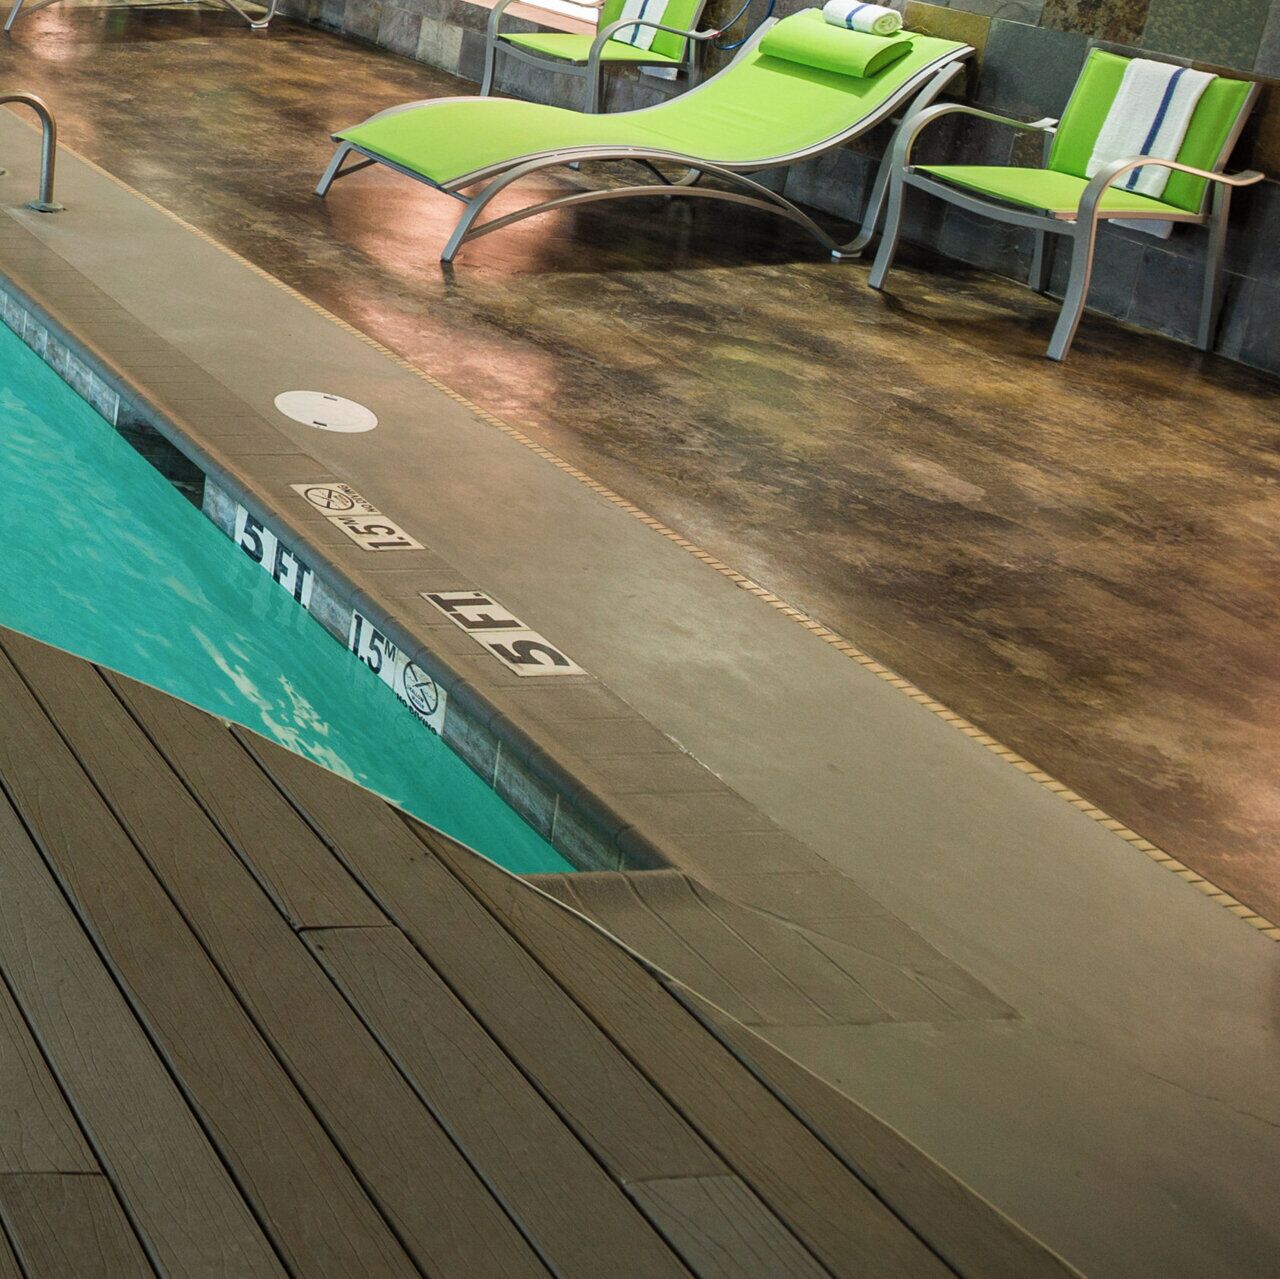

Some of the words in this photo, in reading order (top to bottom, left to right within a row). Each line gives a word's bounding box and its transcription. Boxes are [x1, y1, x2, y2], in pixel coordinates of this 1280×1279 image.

[336, 484, 367, 504] DIVING
[361, 504, 378, 512] NO
[240, 515, 264, 564] 5
[490, 639, 570, 667] 5
[396, 693, 408, 708] NO
[408, 706, 438, 736] DIVING
